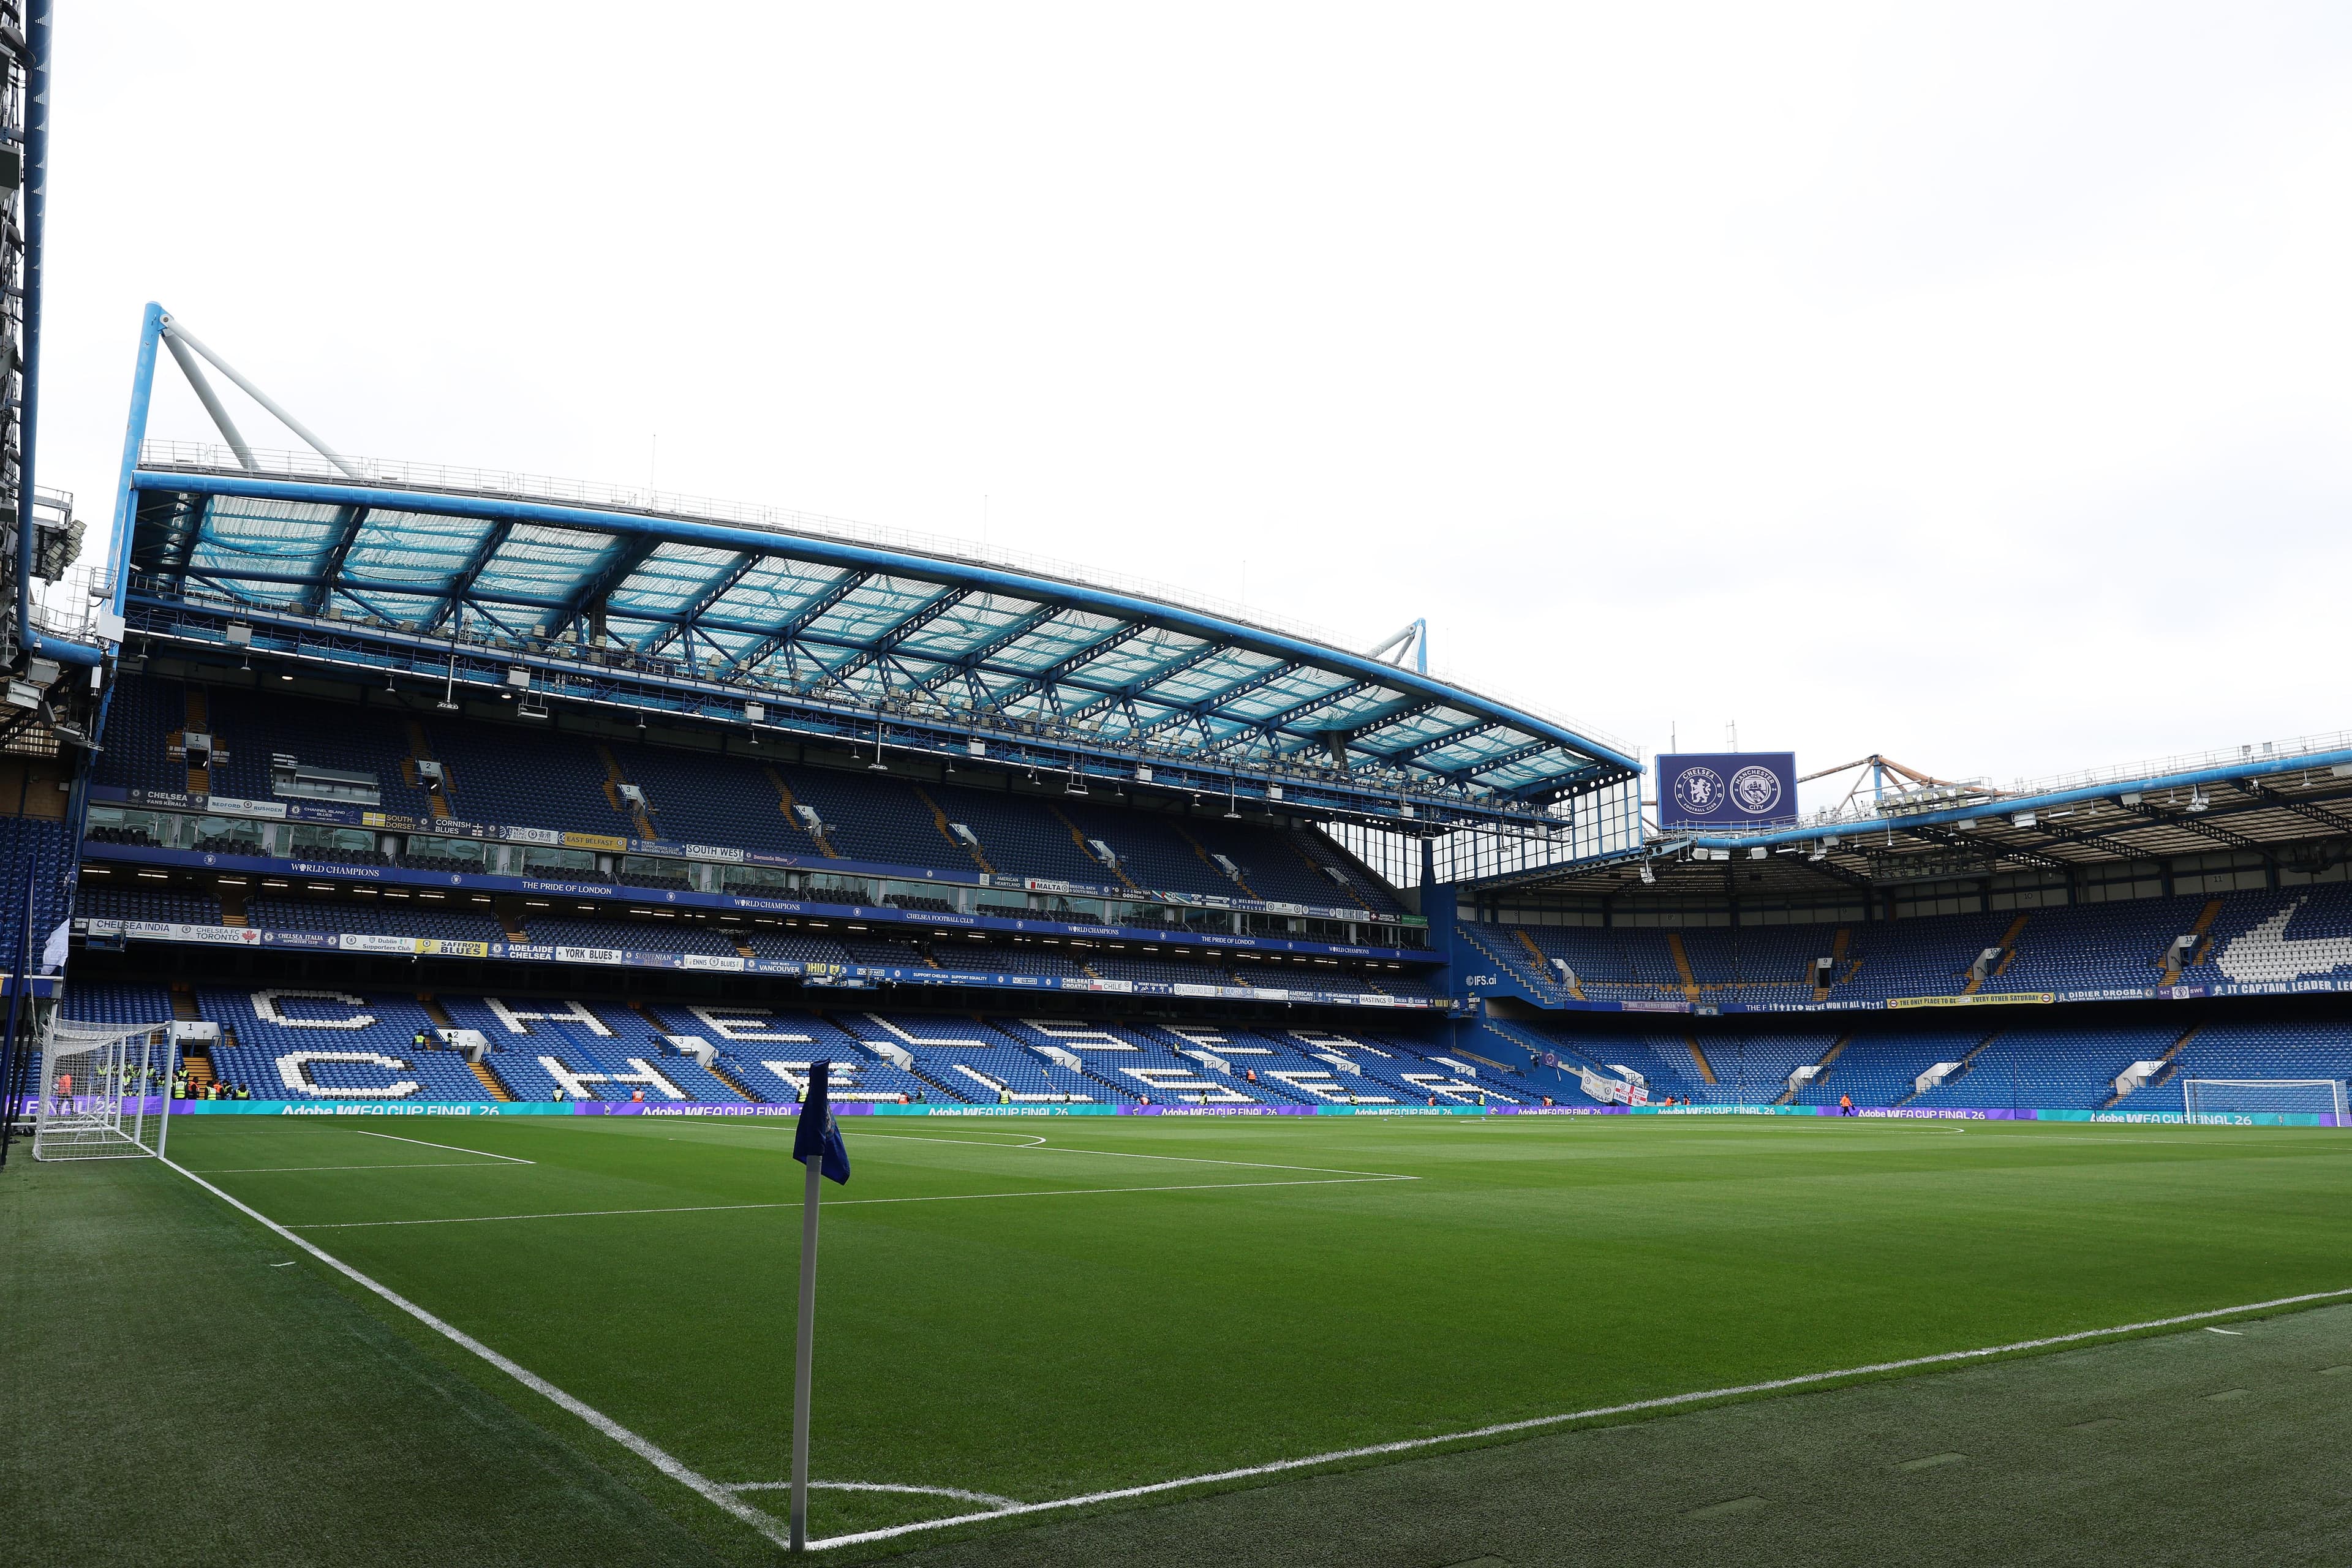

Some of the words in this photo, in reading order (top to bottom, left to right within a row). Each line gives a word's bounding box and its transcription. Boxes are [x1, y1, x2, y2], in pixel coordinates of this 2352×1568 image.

[1683, 769, 1715, 780] CHELSEA
[1735, 769, 1774, 785] MANCHESTER
[148, 791, 187, 801] CHELSEA
[1683, 803, 1705, 812] FOOTBALL
[1706, 802, 1717, 811] CLUB
[386, 821, 417, 831] DORSET
[435, 818, 471, 829] CORNISH
[435, 826, 459, 835] BLUES
[687, 845, 717, 855] SOUTH
[720, 848, 743, 858] WEST
[326, 865, 379, 877] CHAMPIONS
[540, 883, 564, 891] PRIDE
[578, 886, 612, 894] LONDON
[760, 900, 801, 911] CHAMPIONS
[932, 914, 959, 923] FOOTBALL
[97, 920, 142, 930] CHELSEA
[145, 922, 170, 932] INDIA
[440, 947, 481, 956] BLUES
[508, 944, 553, 953] ADELAIDE
[565, 948, 585, 958] YORK
[589, 950, 612, 960] BLUES
[509, 952, 551, 960] CHELSEA
[635, 952, 672, 961] SLOVENIAN
[805, 962, 826, 973] OHIO
[1474, 973, 1497, 986] IFS.ai
[2227, 984, 2237, 994] JT
[2242, 982, 2290, 994] CAPTAIN,
[2292, 980, 2335, 992] LEADER,
[2103, 989, 2143, 997] DROGBA
[282, 1105, 333, 1115] Adobe
[387, 1105, 424, 1115] CUP
[427, 1105, 470, 1115] FINAL
[480, 1105, 500, 1115] 26
[642, 1106, 682, 1115] Adobe
[725, 1106, 753, 1115] CUP
[756, 1106, 791, 1115] FINAL
[1858, 1109, 1886, 1118] Adobe
[1915, 1110, 1937, 1118] CUP
[1939, 1110, 1970, 1120] FINAL
[1972, 1111, 1985, 1120] 26
[2090, 1113, 2125, 1122] Adobe
[2234, 1115, 2252, 1125] 26
